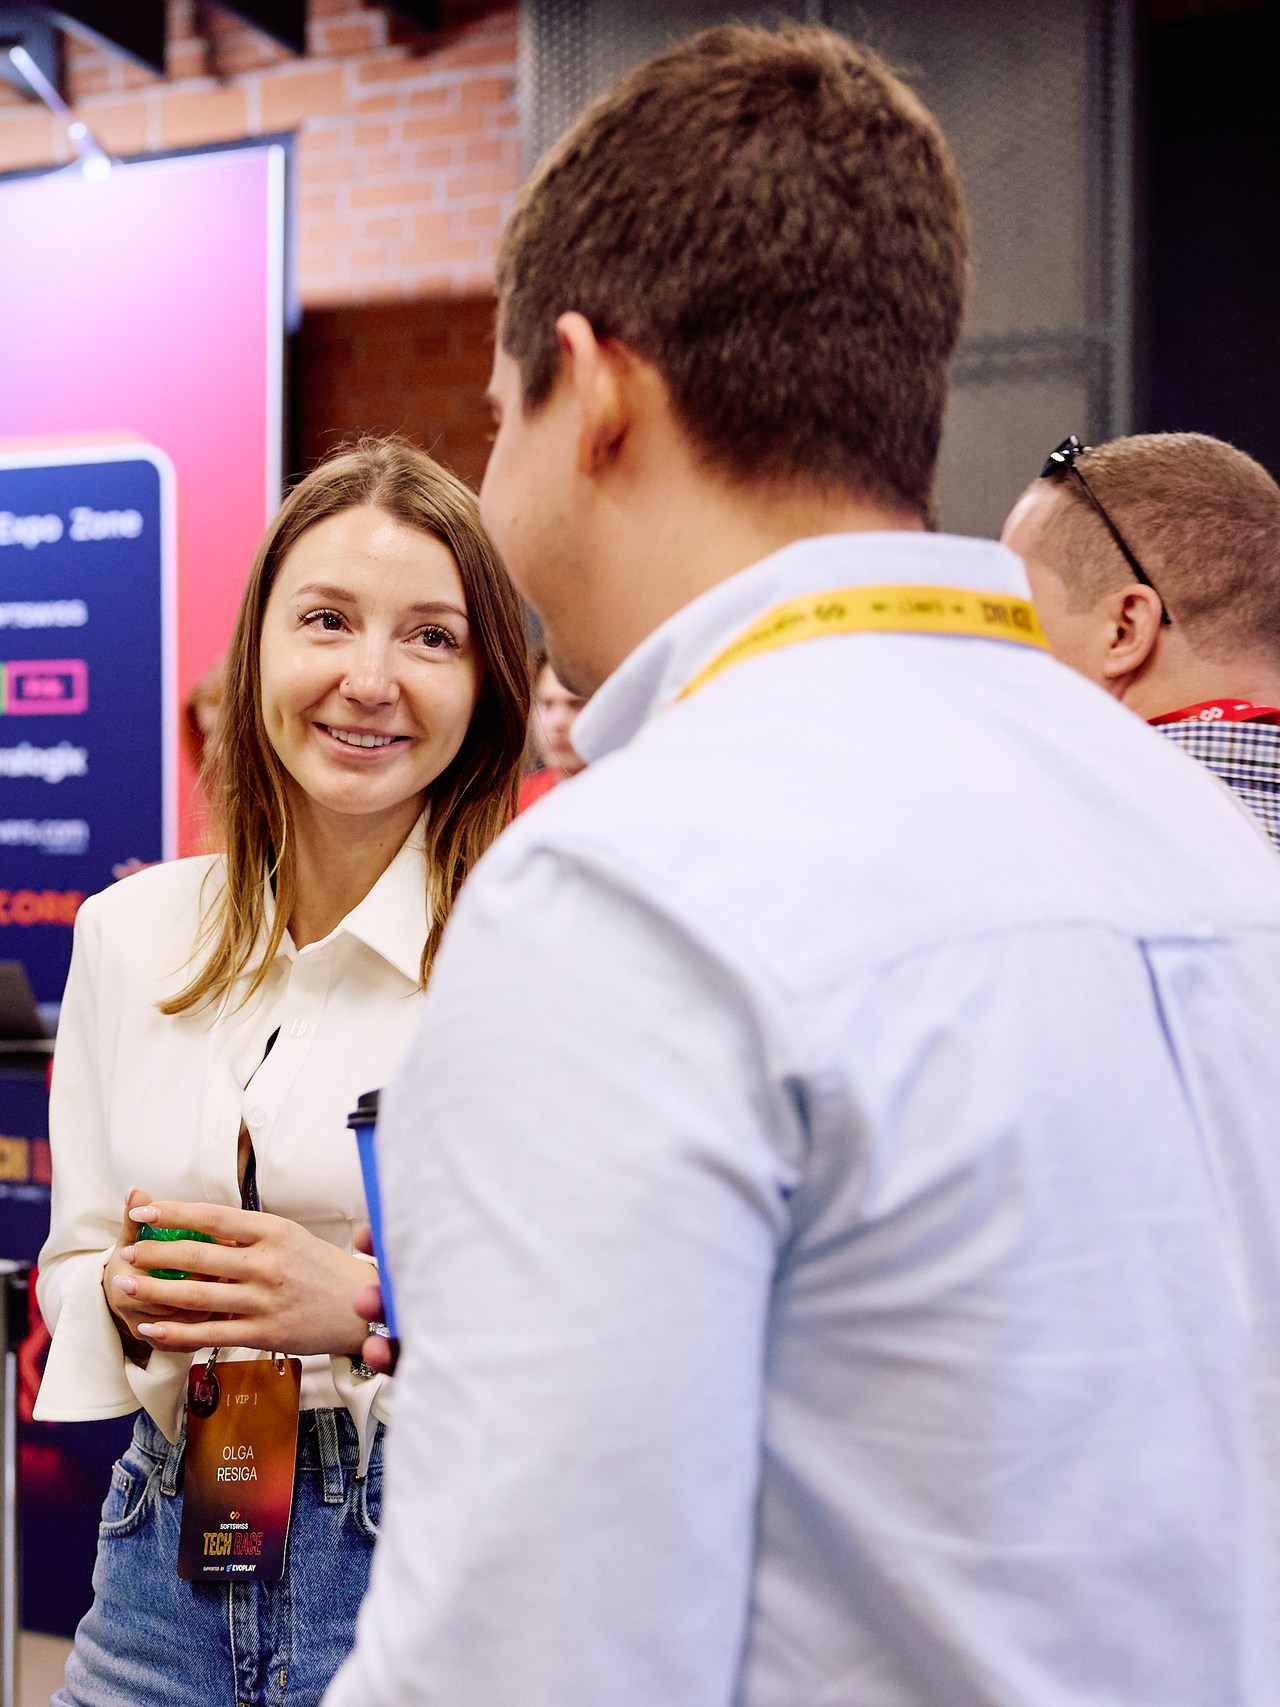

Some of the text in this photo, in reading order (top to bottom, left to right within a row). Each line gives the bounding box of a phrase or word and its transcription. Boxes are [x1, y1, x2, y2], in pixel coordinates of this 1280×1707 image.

[69, 506, 143, 542] Zone
[235, 1394, 249, 1404] VIP
[223, 1445, 254, 1460] OLGA
[217, 1467, 257, 1481] RESIGA
[203, 1532, 263, 1555] TECH RACE
